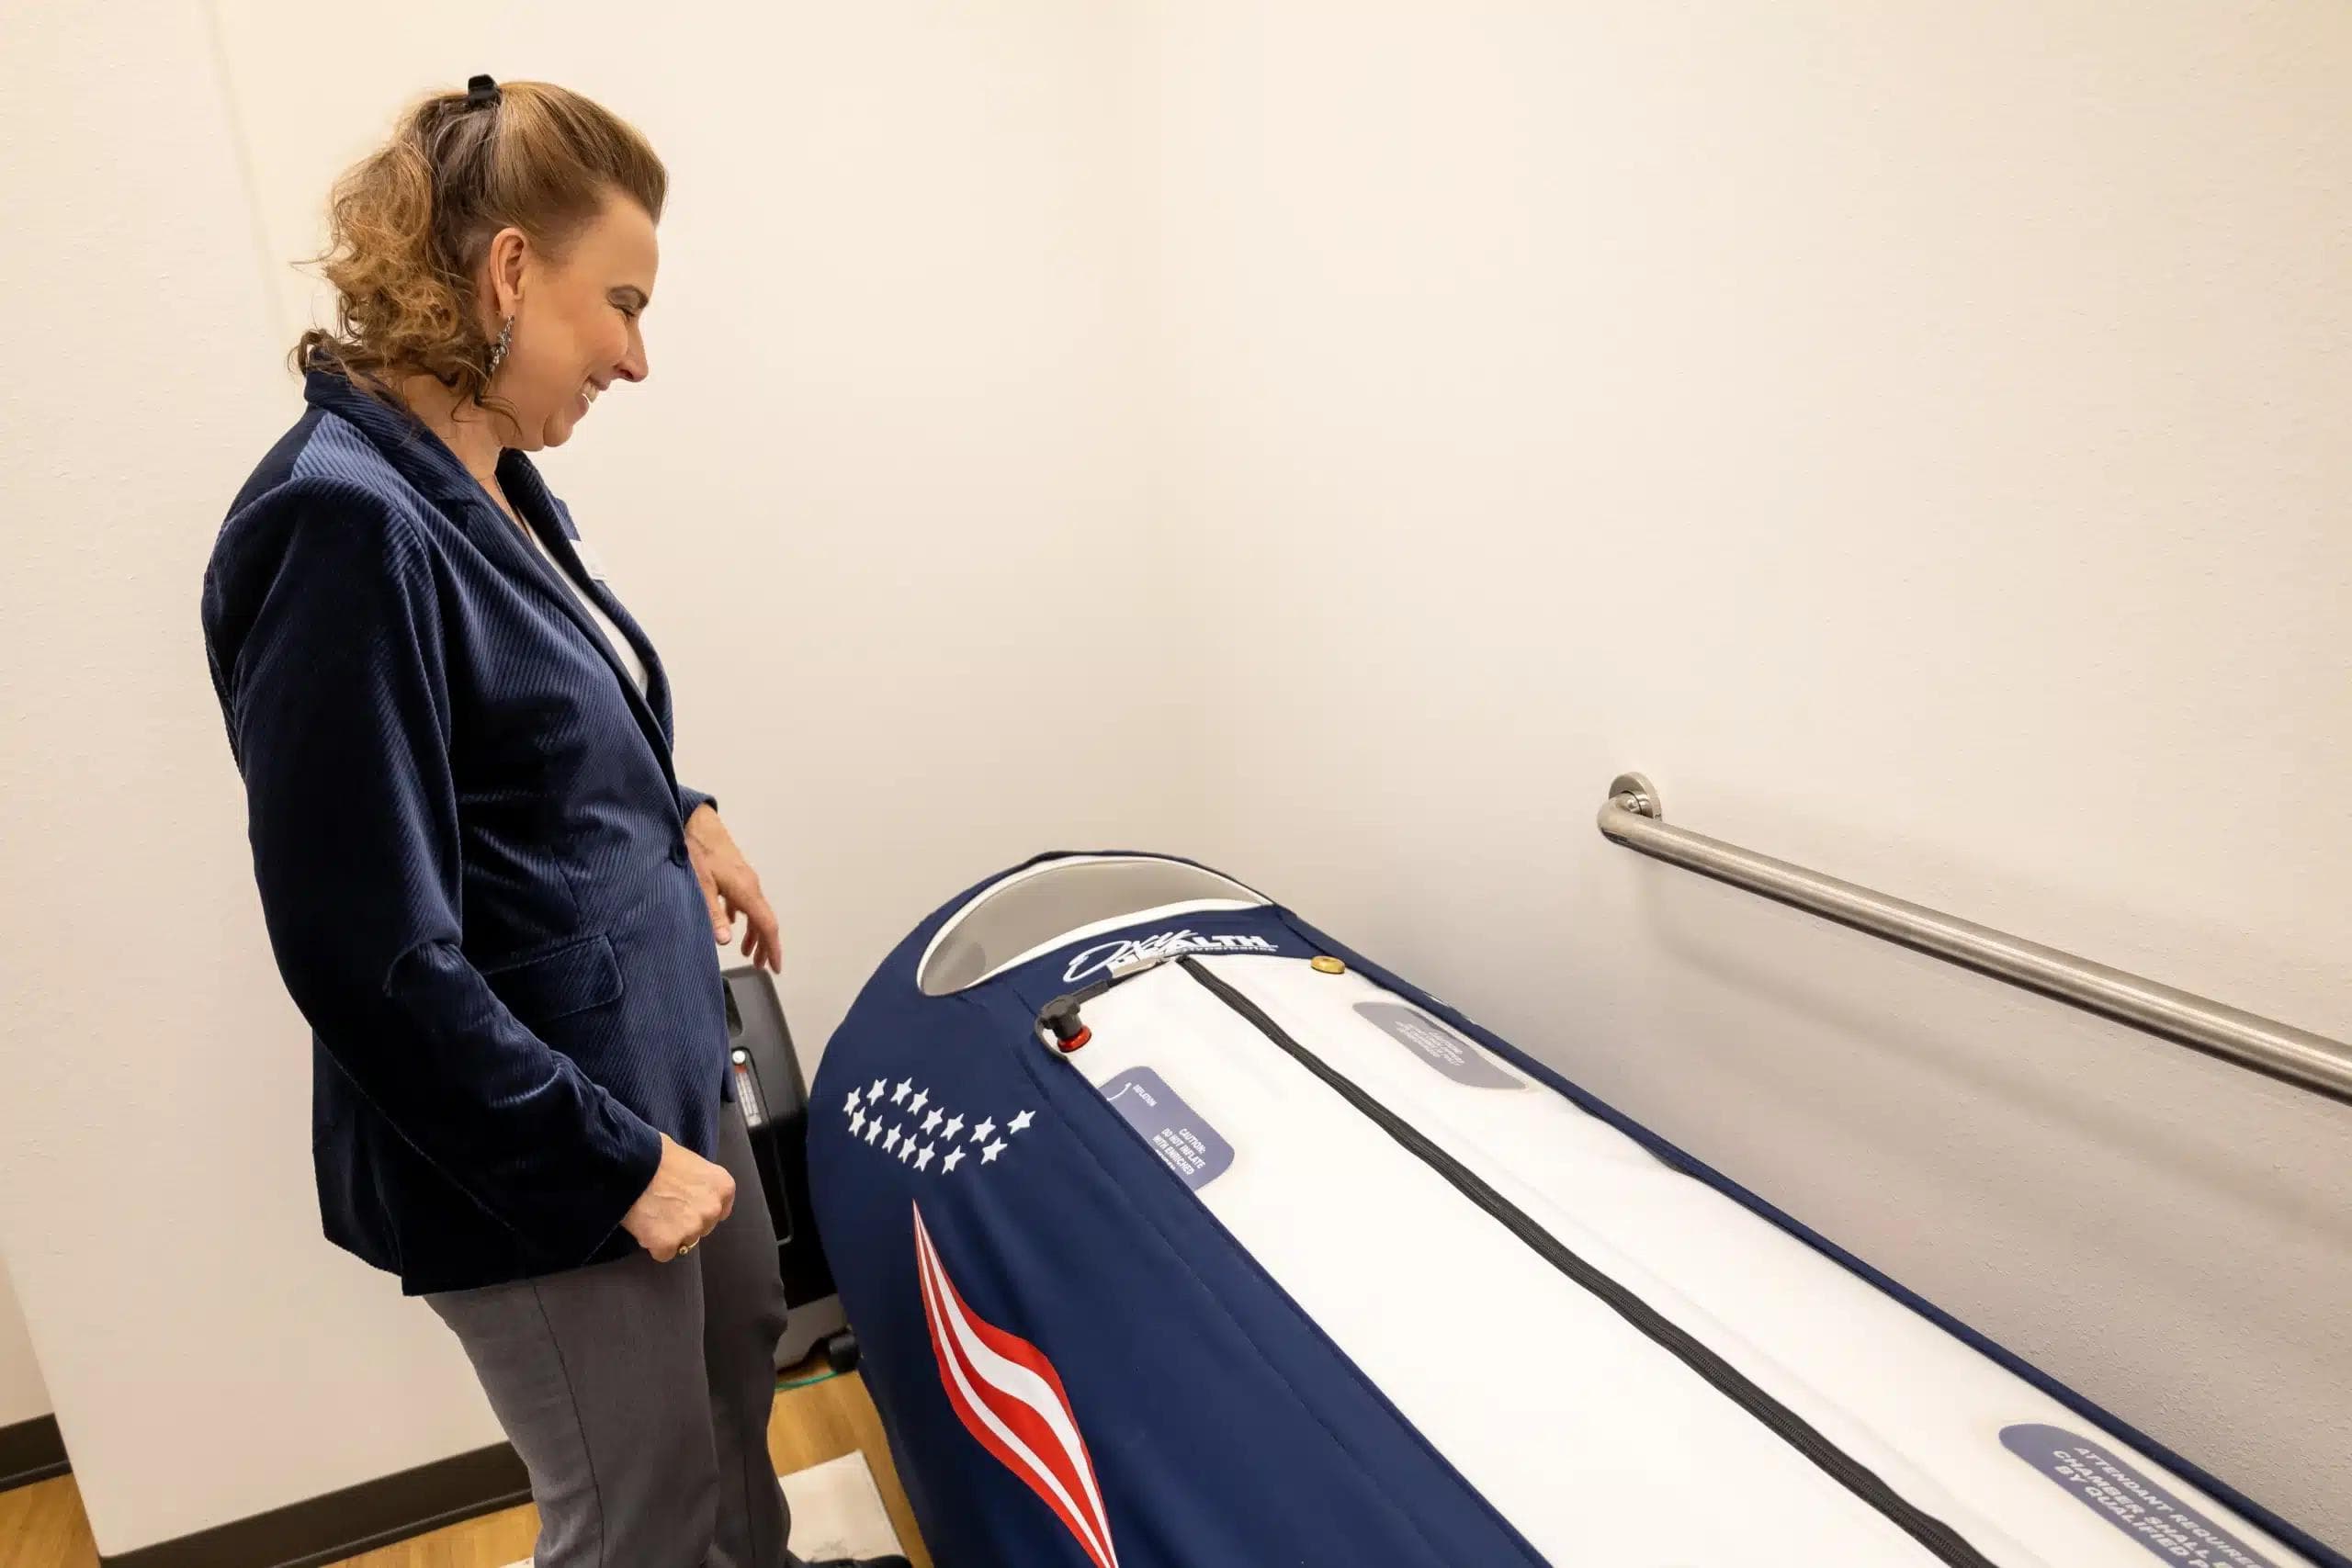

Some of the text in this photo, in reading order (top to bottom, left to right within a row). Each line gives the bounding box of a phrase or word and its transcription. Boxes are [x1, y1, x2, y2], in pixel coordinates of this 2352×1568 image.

[1152, 1134, 1169, 1149] WITH
[1164, 1146, 1195, 1175] ENRICHED
[1161, 1128, 1173, 1138] DO
[1169, 1134, 1184, 1147] NOT
[1179, 1145, 1206, 1169] INFLATE
[1179, 1128, 1206, 1155] CAUTION:
[2052, 1450, 2210, 1559] CHAMBER SHALL
[2074, 1448, 2176, 1512] ATTENDANT
[2054, 1466, 2189, 1556] BY QUALIFIED
